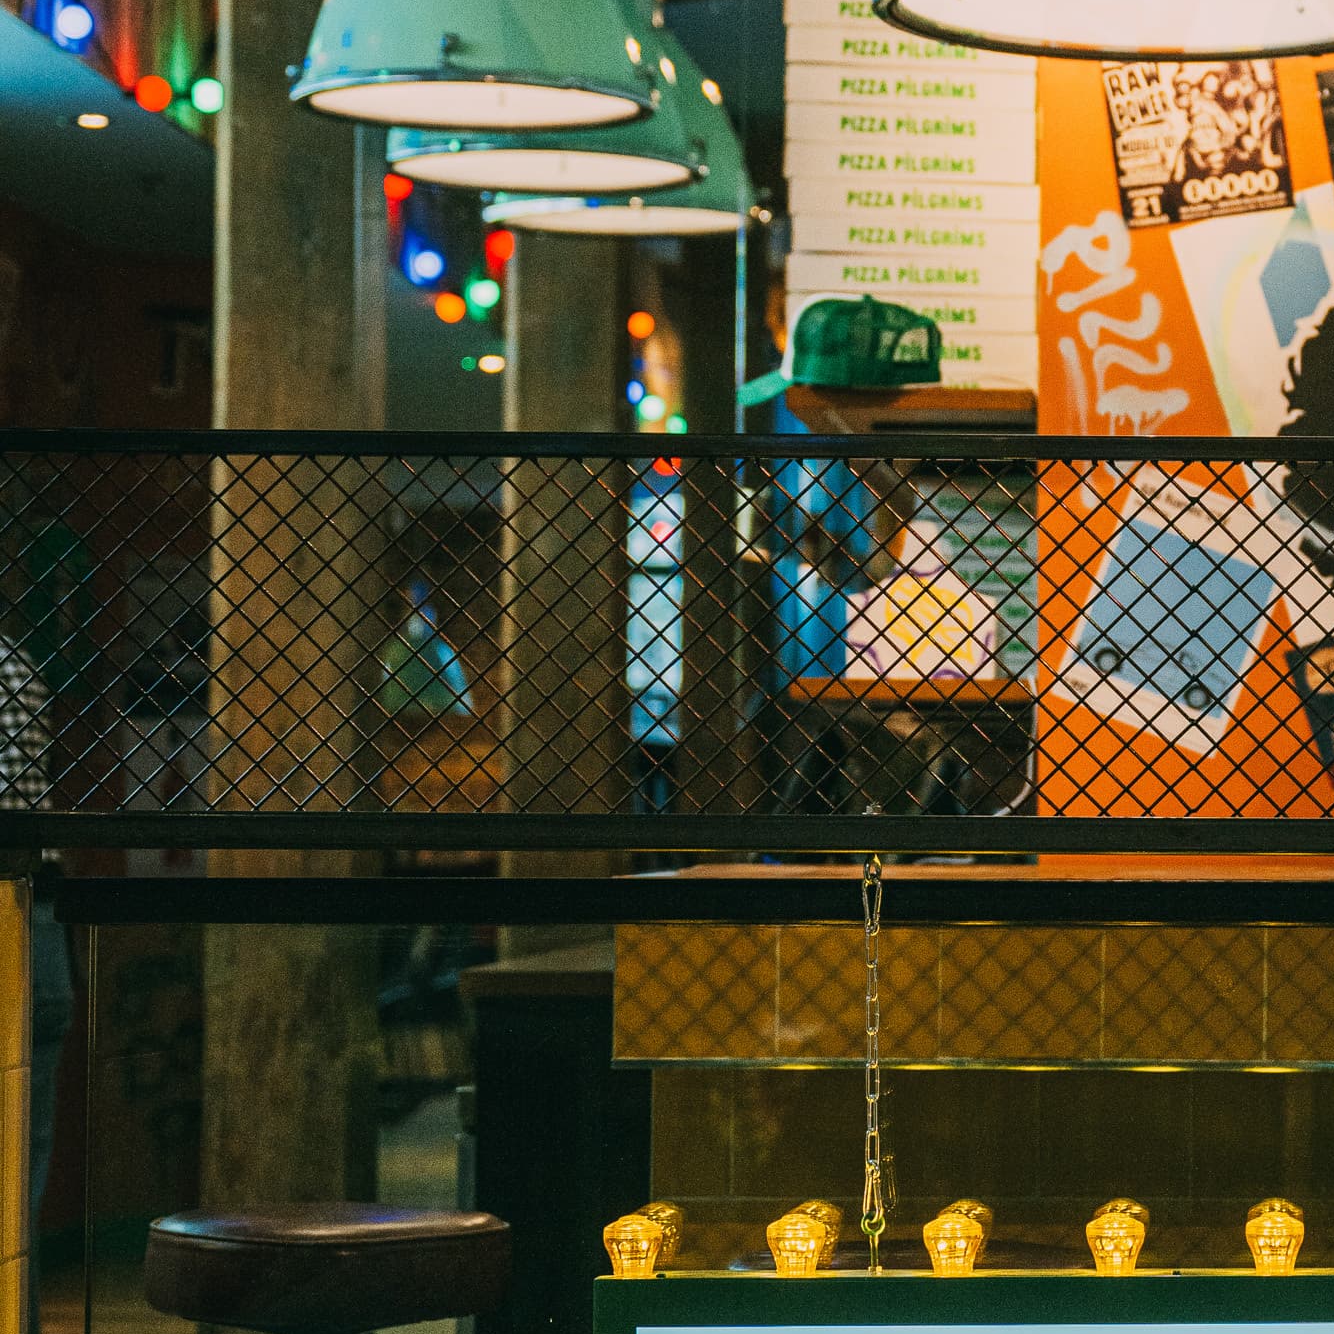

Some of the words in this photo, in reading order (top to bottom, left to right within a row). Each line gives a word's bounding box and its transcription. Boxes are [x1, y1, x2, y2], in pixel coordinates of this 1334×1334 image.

[839, 1, 873, 18] PIZZ
[843, 38, 891, 56] PIZZA
[840, 78, 888, 95] PIZZA
[1108, 64, 1161, 97] RAW
[840, 116, 888, 133] PIZZA
[839, 153, 887, 170] PIZZA
[847, 191, 895, 207] PIZZA
[849, 227, 897, 244] PIZZA
[842, 266, 891, 282] PIZZA
